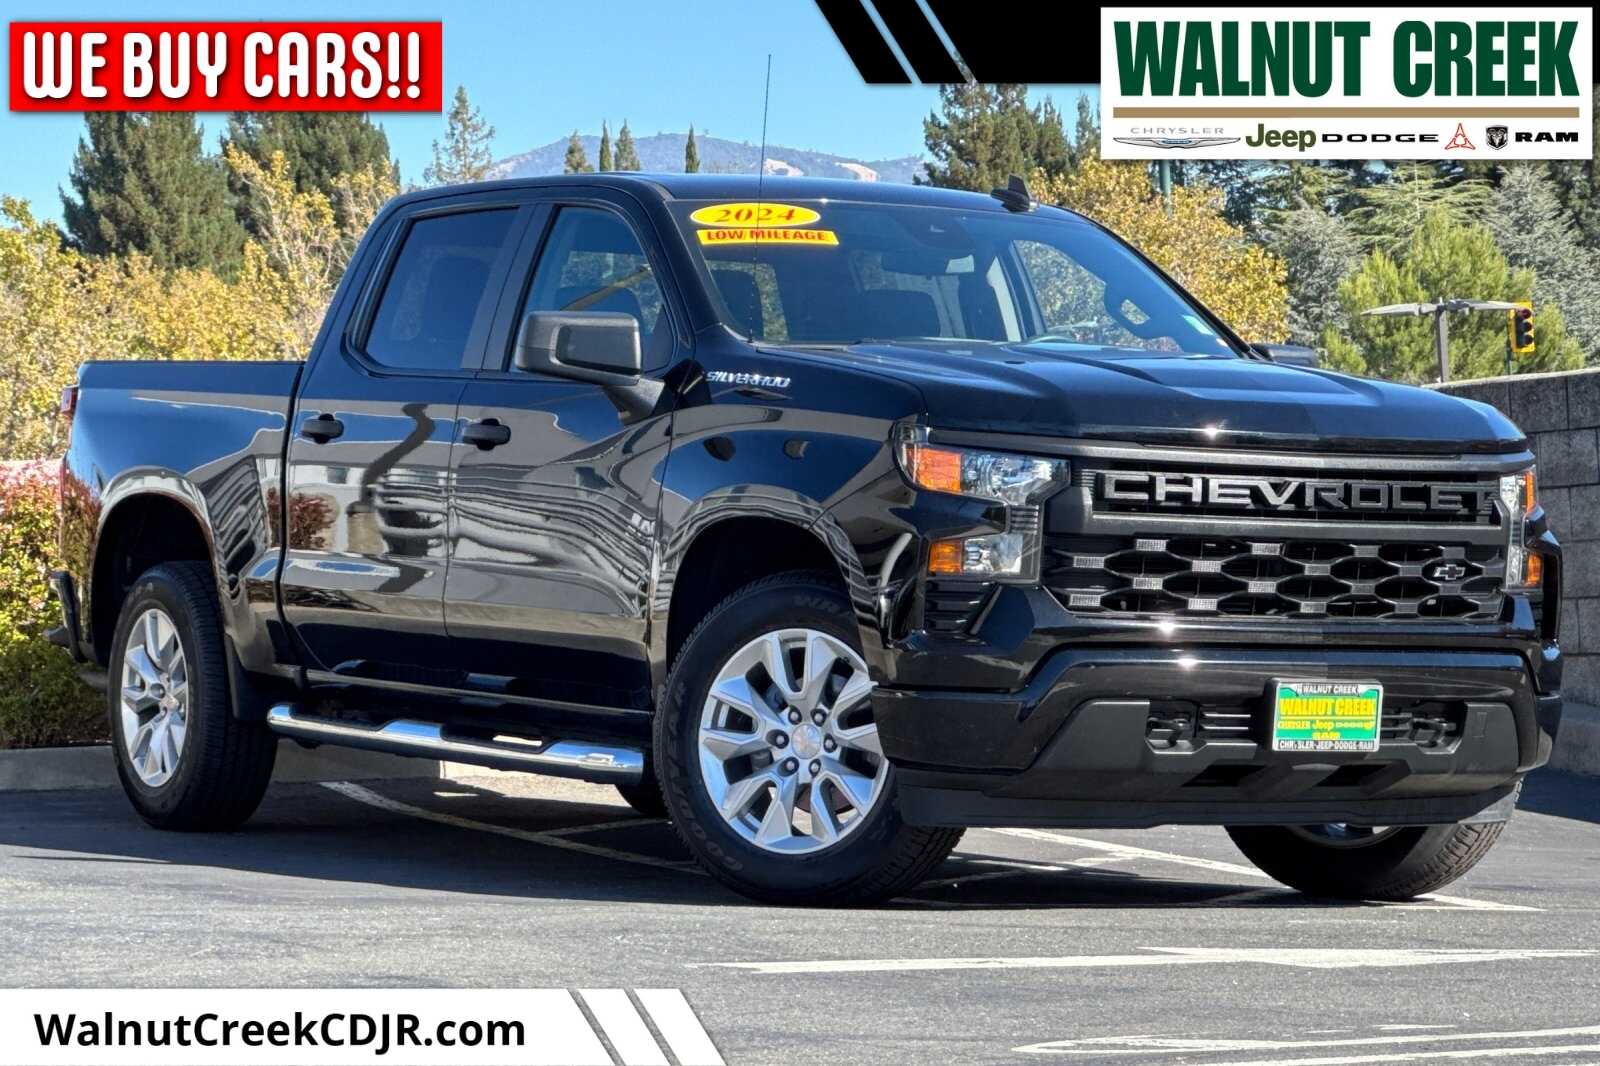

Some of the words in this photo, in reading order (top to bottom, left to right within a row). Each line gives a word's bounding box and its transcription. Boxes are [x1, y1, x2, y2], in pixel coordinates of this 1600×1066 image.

[714, 207, 796, 223] 2024
[706, 230, 743, 241] LOW
[749, 230, 825, 241] MILEAGE
[1104, 473, 1497, 512] CHEVROLET
[1303, 685, 1332, 694] WALNUT
[1333, 685, 1357, 694] CREEK
[1280, 698, 1334, 715] WALNUT
[1335, 699, 1375, 715] CREEK
